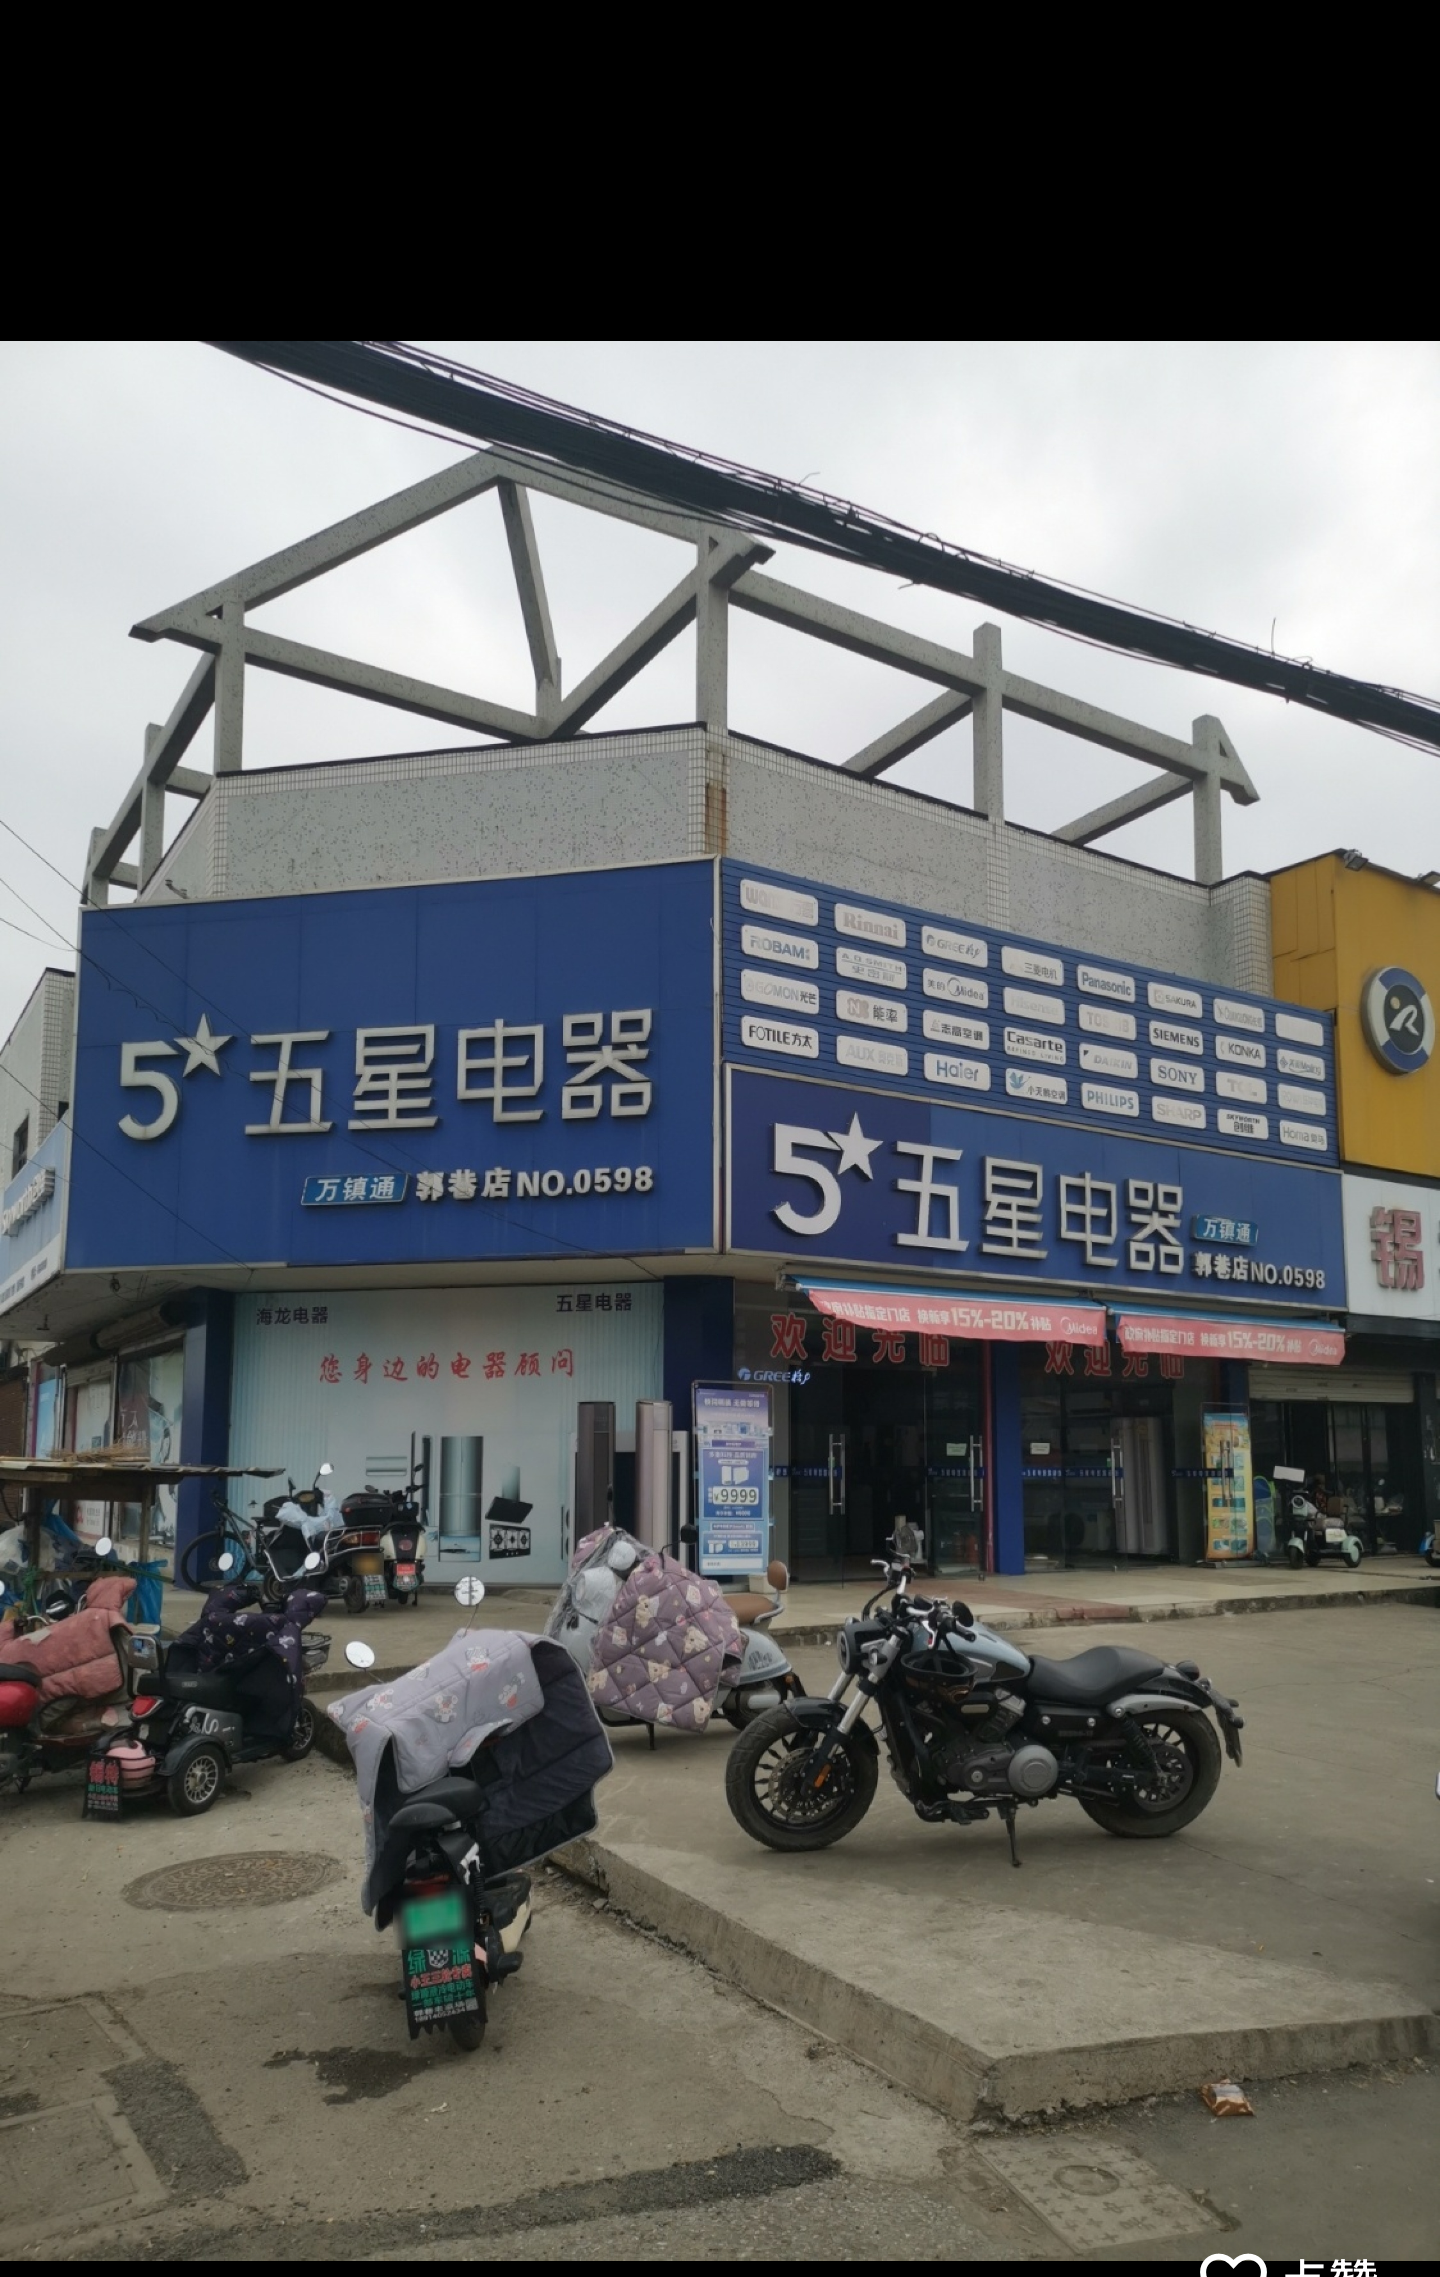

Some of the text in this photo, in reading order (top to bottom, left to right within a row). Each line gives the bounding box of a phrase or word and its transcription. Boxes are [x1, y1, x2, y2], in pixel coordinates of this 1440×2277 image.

[843, 911, 898, 940] Rinnai
[750, 935, 805, 959] ROBAM
[1024, 962, 1057, 980] 三菱电机
[928, 979, 984, 1001] 美的 Midea
[1082, 972, 1132, 996] Panasonic
[1165, 995, 1197, 1009] SAKURA
[872, 1005, 898, 1022] 能率
[941, 1024, 983, 1041] 志高空调
[1007, 1031, 1063, 1053] Casarte
[1153, 1027, 1200, 1048] SIEMENS
[846, 1044, 874, 1061] AUX
[1228, 1043, 1261, 1060] KONKA
[244, 1009, 653, 1136] 五星电器
[936, 1060, 978, 1081] Haier
[1094, 1055, 1132, 1070] DAIKIN
[1158, 1065, 1197, 1085] SONY
[1028, 1086, 1066, 1100] 小天鹅空调
[1087, 1090, 1134, 1110] PHILIPS
[1157, 1103, 1201, 1121] SHARP
[1226, 1114, 1260, 1124] SKYWORTH
[1283, 1126, 1310, 1141] Homa
[314, 1176, 398, 1203] 万镇通
[895, 1140, 1186, 1275] 五星电器
[1202, 1217, 1252, 1244] 万镇通
[1370, 1205, 1425, 1291] 锡
[556, 1293, 633, 1313] 五星电器
[256, 1305, 329, 1326] 海龙电器
[1063, 1317, 1098, 1335] Midea
[320, 1348, 575, 1384] 您身边的电器顾问
